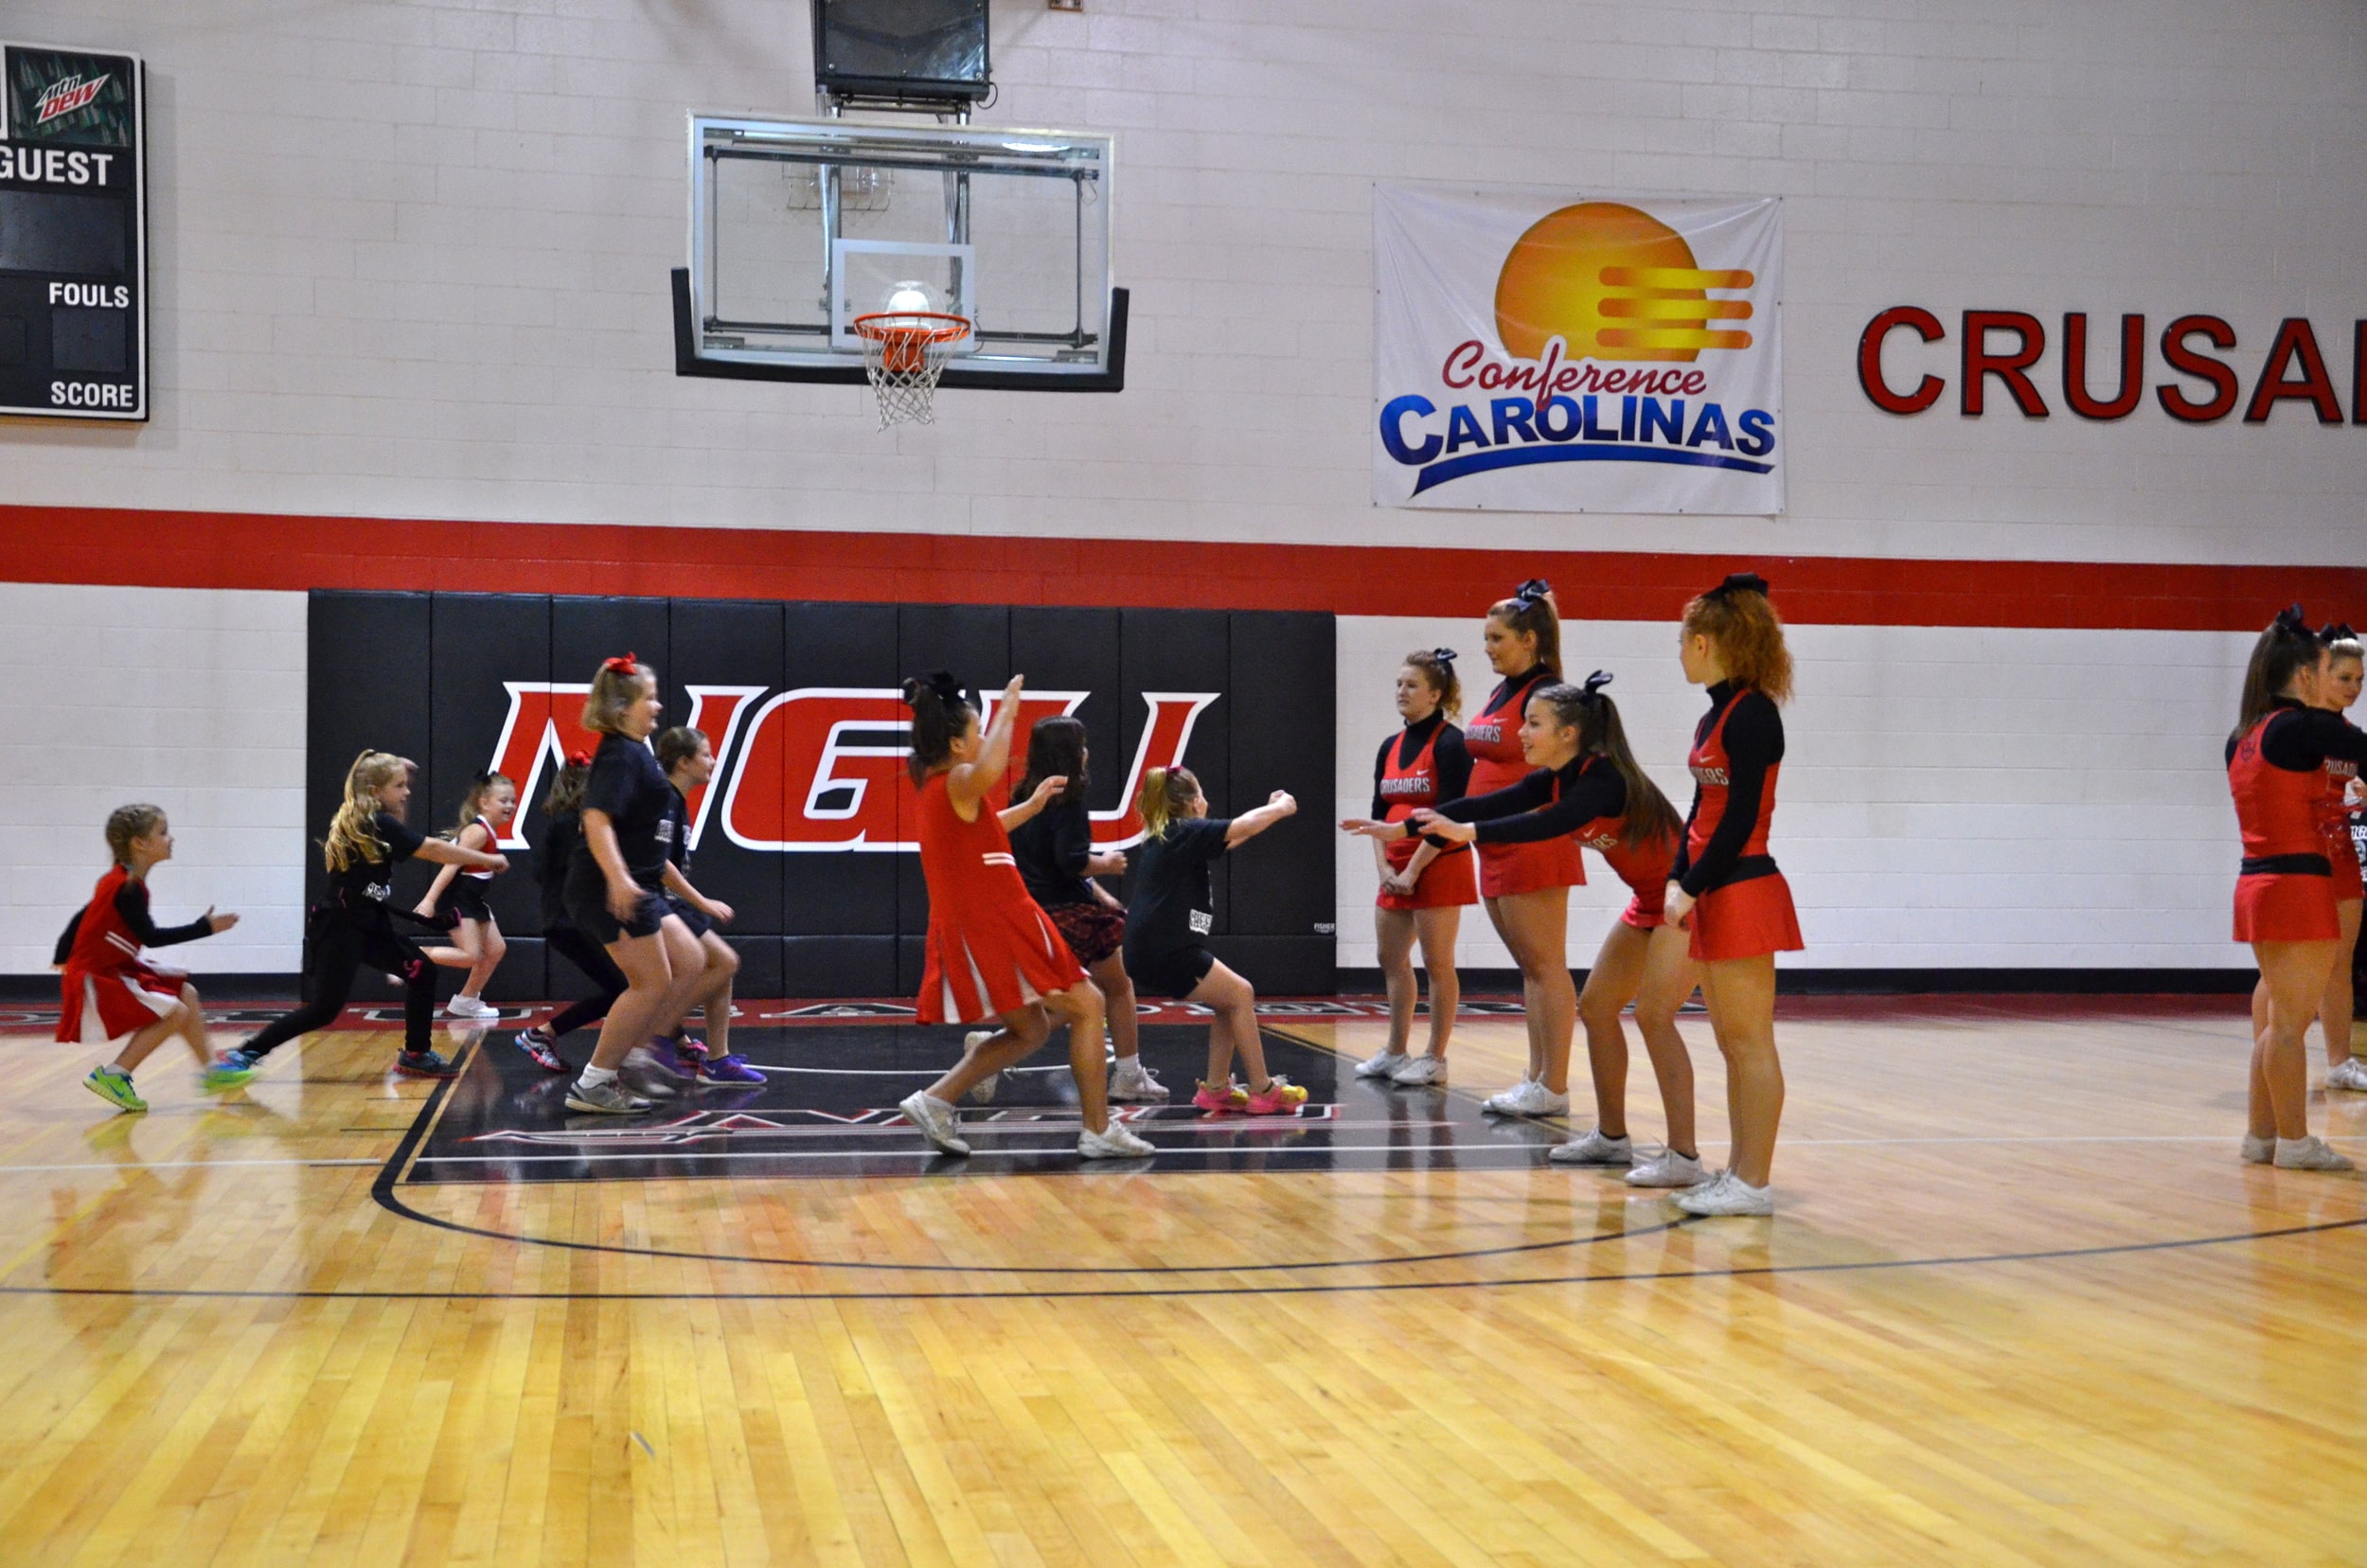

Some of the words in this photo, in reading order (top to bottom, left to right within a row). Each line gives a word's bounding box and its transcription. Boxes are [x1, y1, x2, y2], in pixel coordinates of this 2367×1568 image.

[49, 282, 129, 308] FOULS
[50, 382, 133, 407] SCORE
[1442, 339, 1707, 411] Conference
[1858, 305, 2367, 426] CRUSA
[1379, 394, 1775, 465] CAROLINAS
